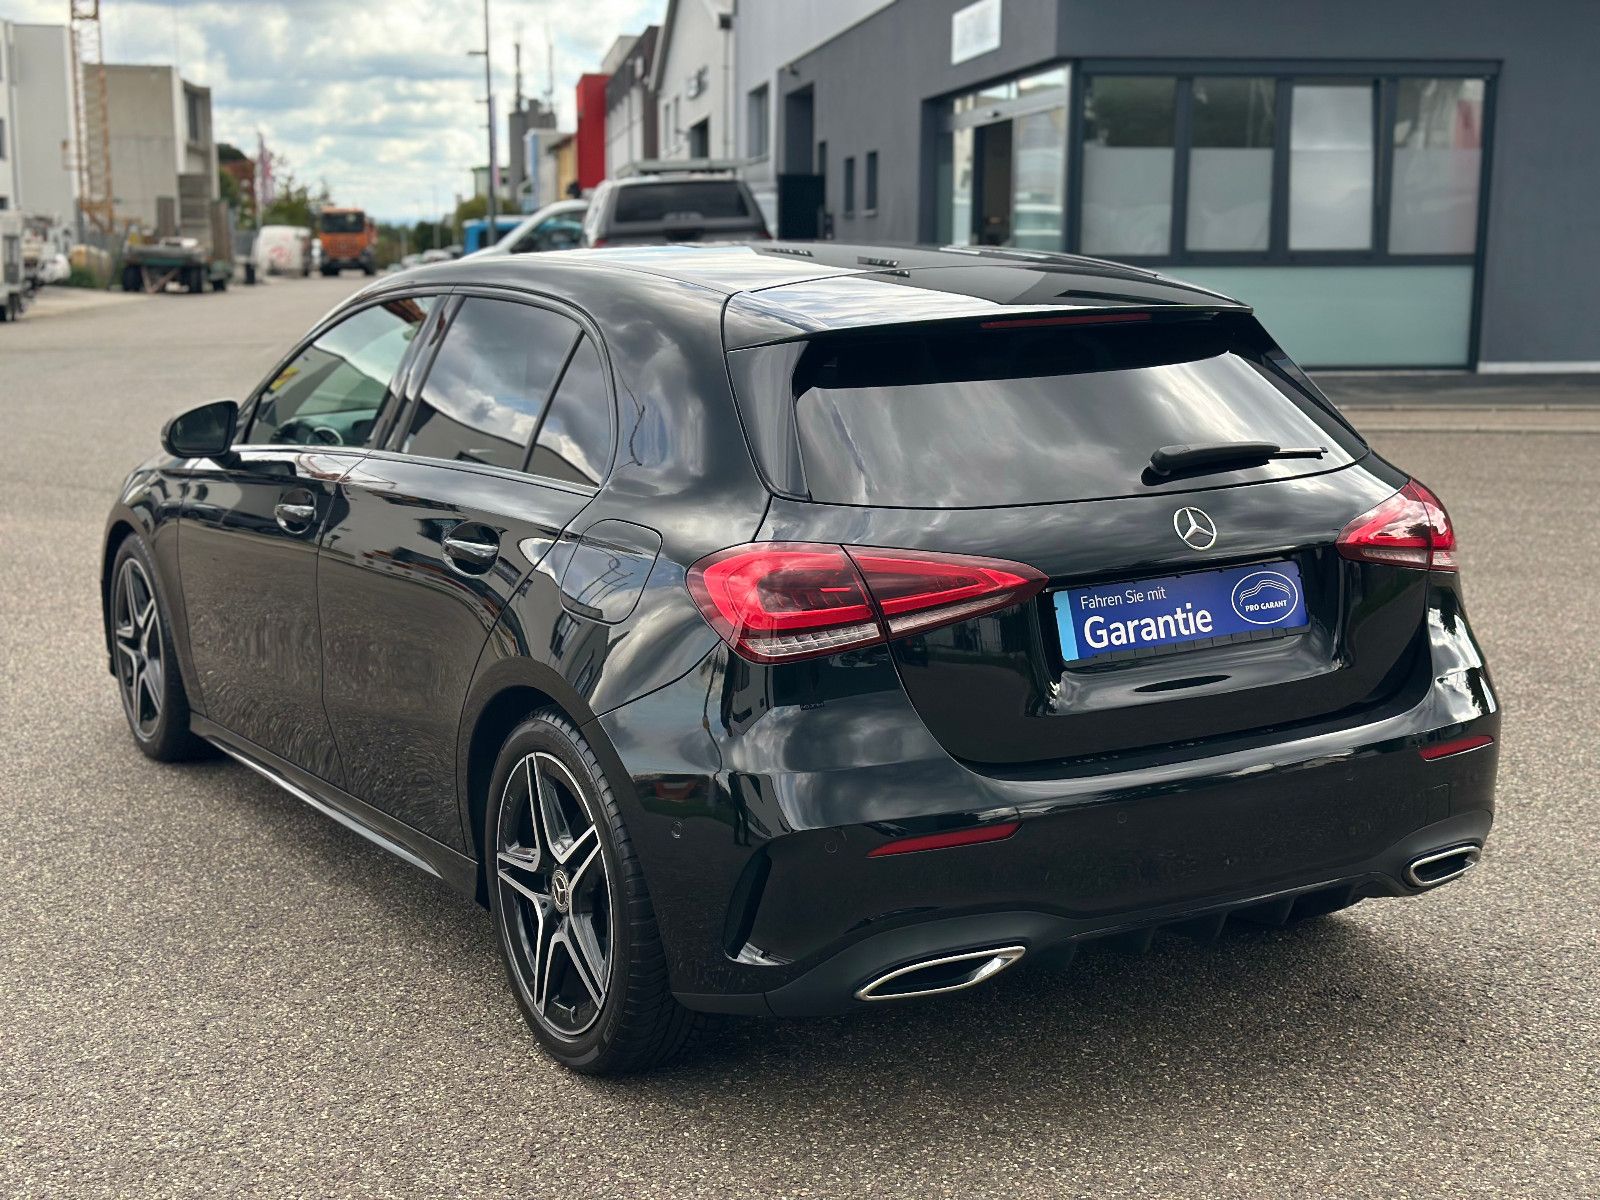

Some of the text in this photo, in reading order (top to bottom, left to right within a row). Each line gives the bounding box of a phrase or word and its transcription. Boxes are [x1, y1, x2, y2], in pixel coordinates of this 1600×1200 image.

[1080, 586, 1167, 610] Fahren Sie mit
[1244, 599, 1288, 613] PRO GARANT
[1084, 602, 1214, 649] Garantie
